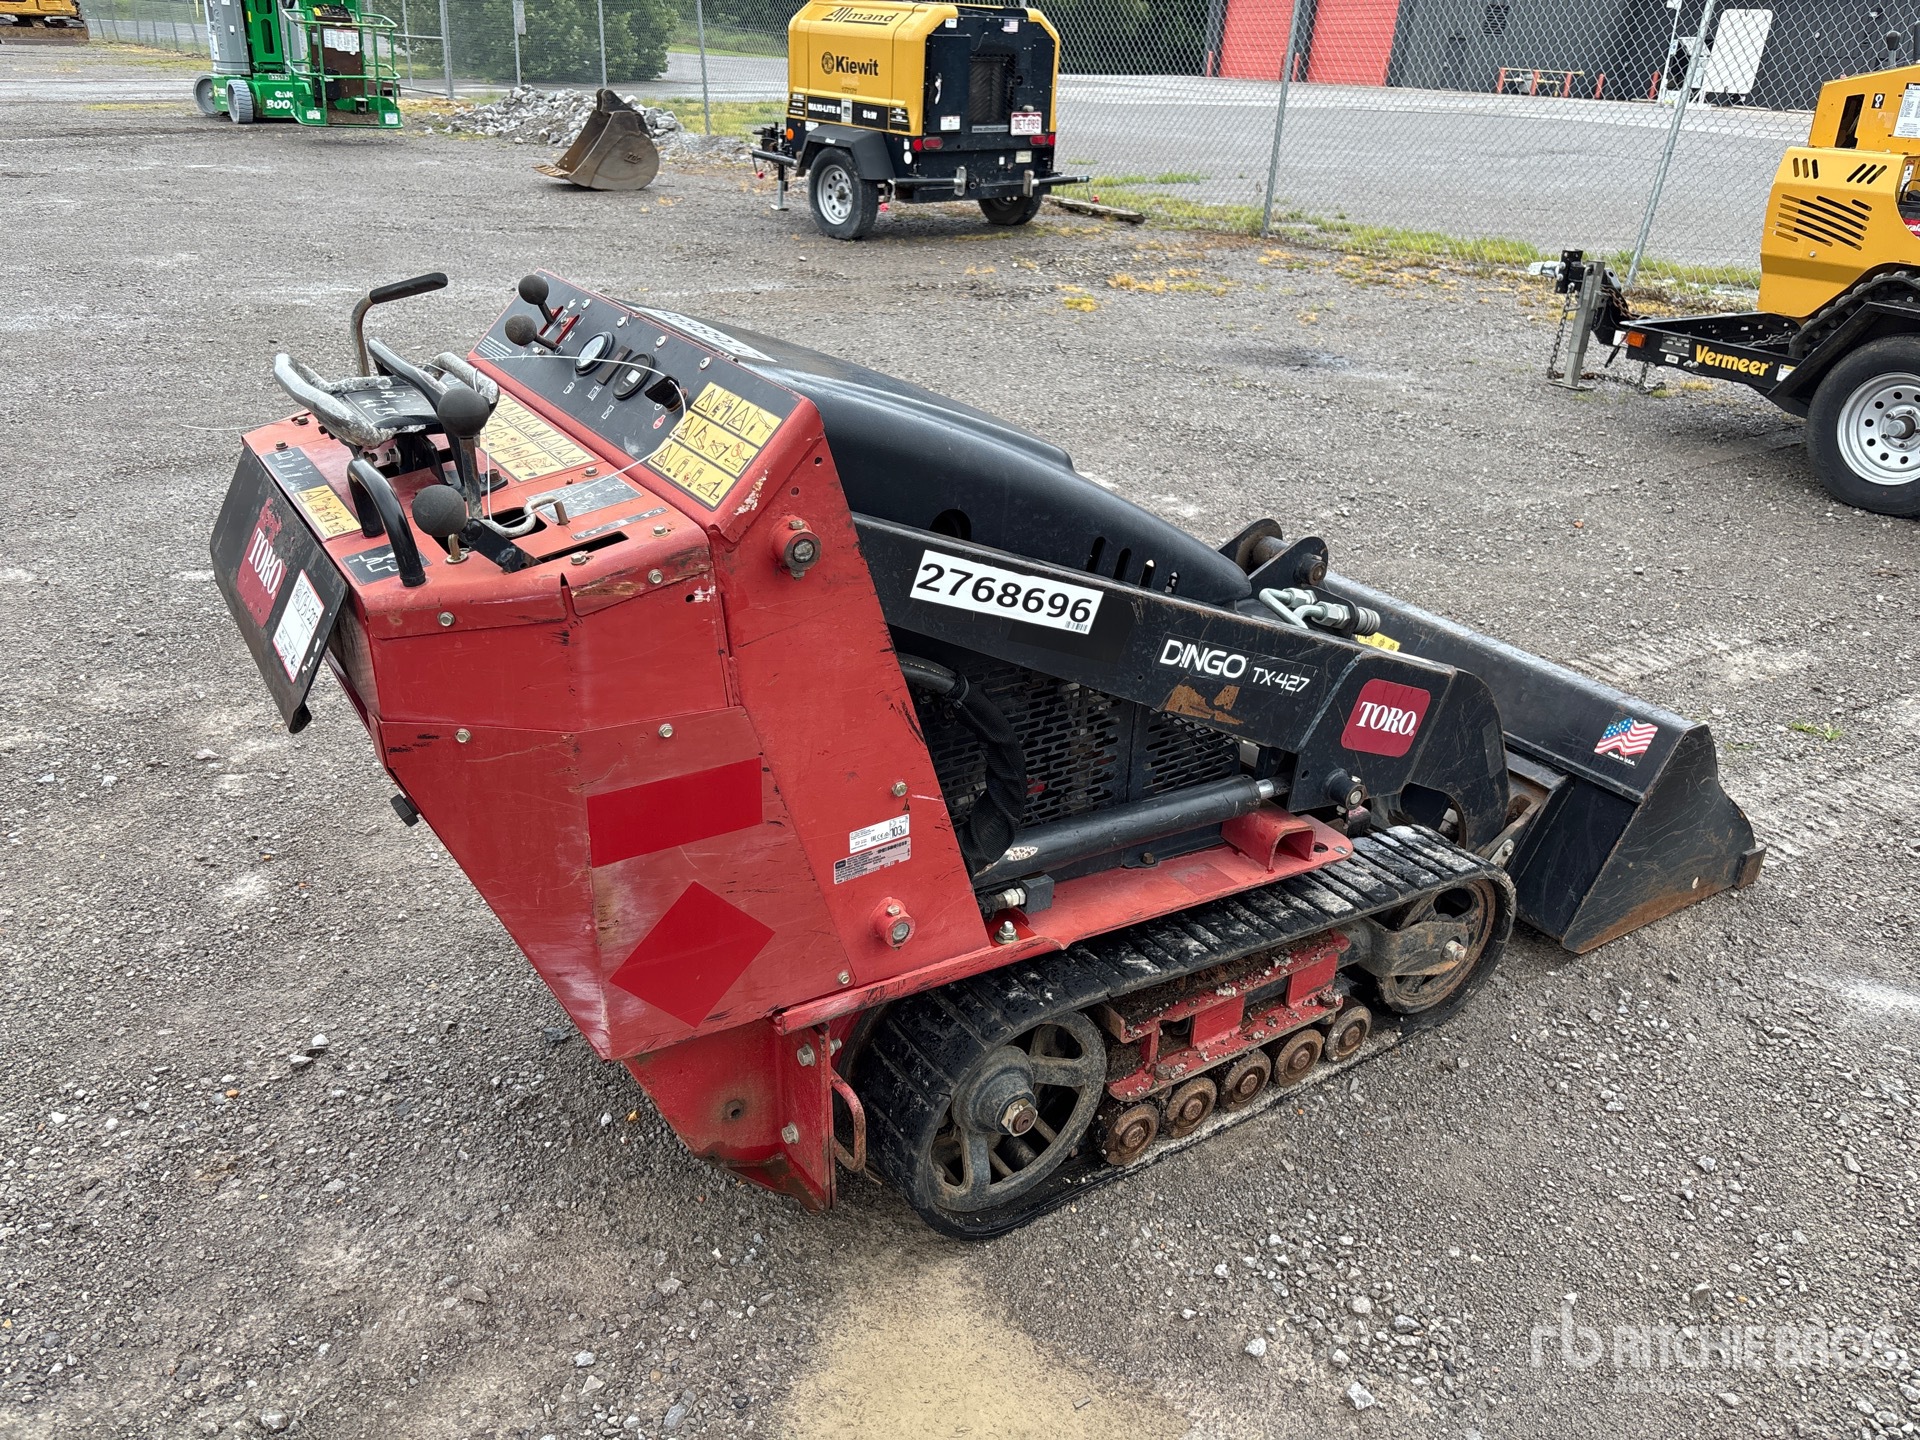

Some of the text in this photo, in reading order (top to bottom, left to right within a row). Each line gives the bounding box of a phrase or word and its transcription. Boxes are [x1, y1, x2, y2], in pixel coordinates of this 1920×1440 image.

[822, 7, 899, 24] Allmand
[835, 55, 879, 76] Kiewit
[1695, 344, 1770, 377] Vermeer
[248, 527, 284, 596] TORO
[916, 562, 1093, 623] 2768696
[1159, 639, 1248, 679] DINGO
[1355, 701, 1417, 736] TORO
